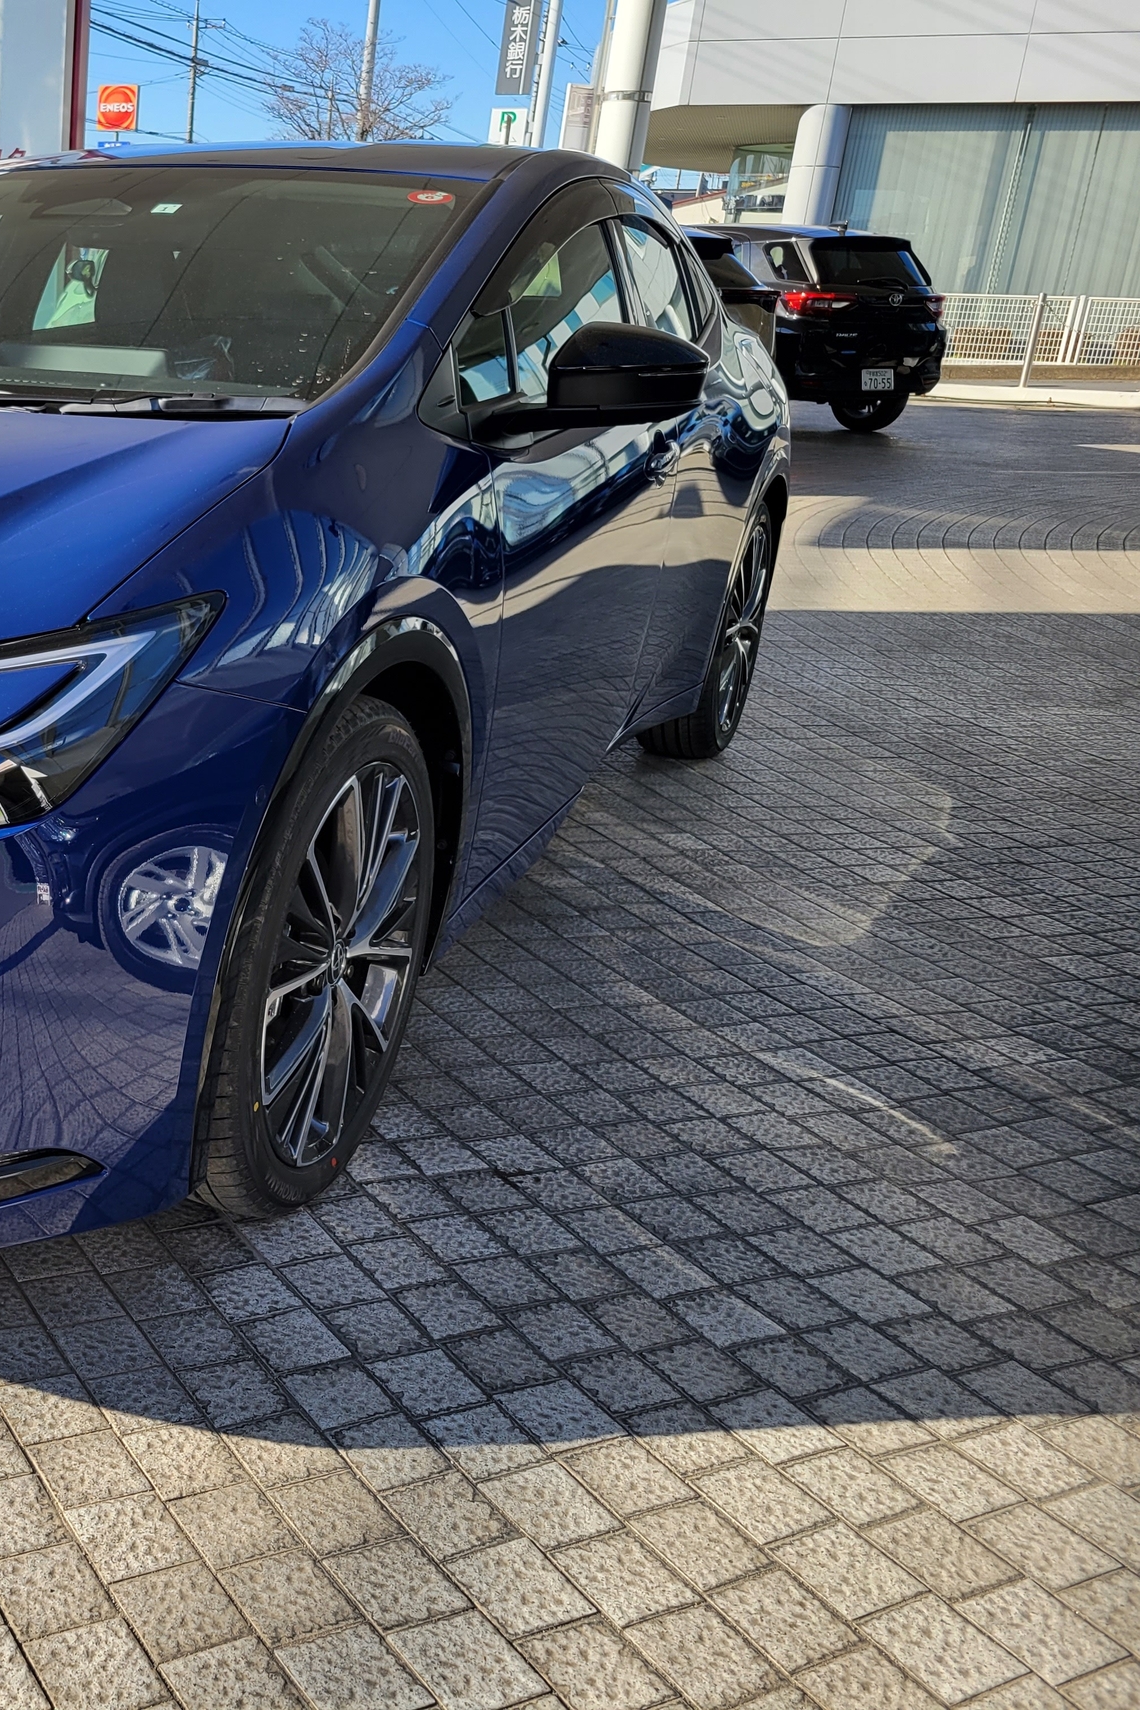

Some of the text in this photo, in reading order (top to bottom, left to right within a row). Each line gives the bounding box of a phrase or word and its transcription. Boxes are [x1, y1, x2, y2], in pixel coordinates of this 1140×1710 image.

[505, 5, 531, 79] 栃木銀行
[99, 102, 135, 113] ENEOS
[499, 111, 517, 132] P
